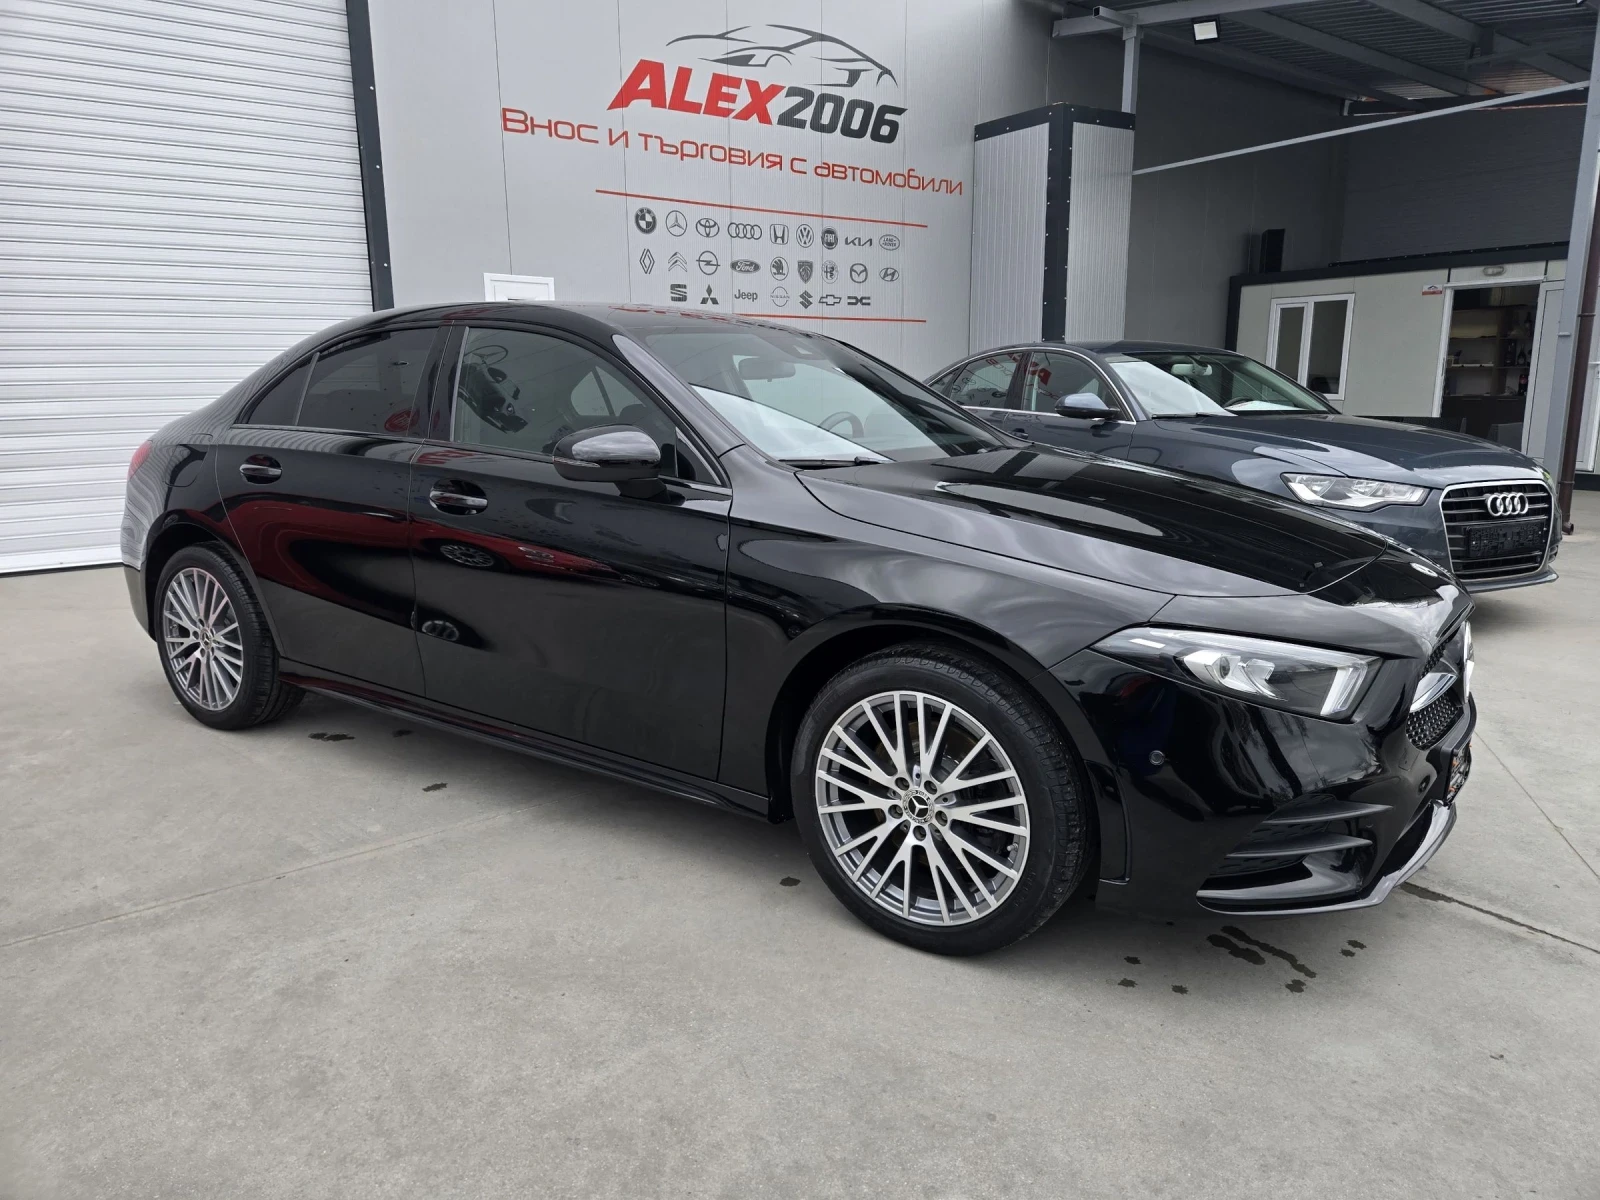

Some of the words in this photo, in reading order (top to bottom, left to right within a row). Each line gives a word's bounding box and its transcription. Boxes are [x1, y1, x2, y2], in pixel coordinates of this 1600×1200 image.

[607, 59, 908, 144] ALEX2006
[501, 107, 599, 144] Внос
[609, 130, 630, 149] и
[638, 133, 783, 172] търговия
[790, 157, 808, 175] с
[813, 161, 964, 196] автомобили
[824, 233, 836, 243] FIAT
[735, 261, 755, 272] Ford
[734, 288, 759, 303] Jeep
